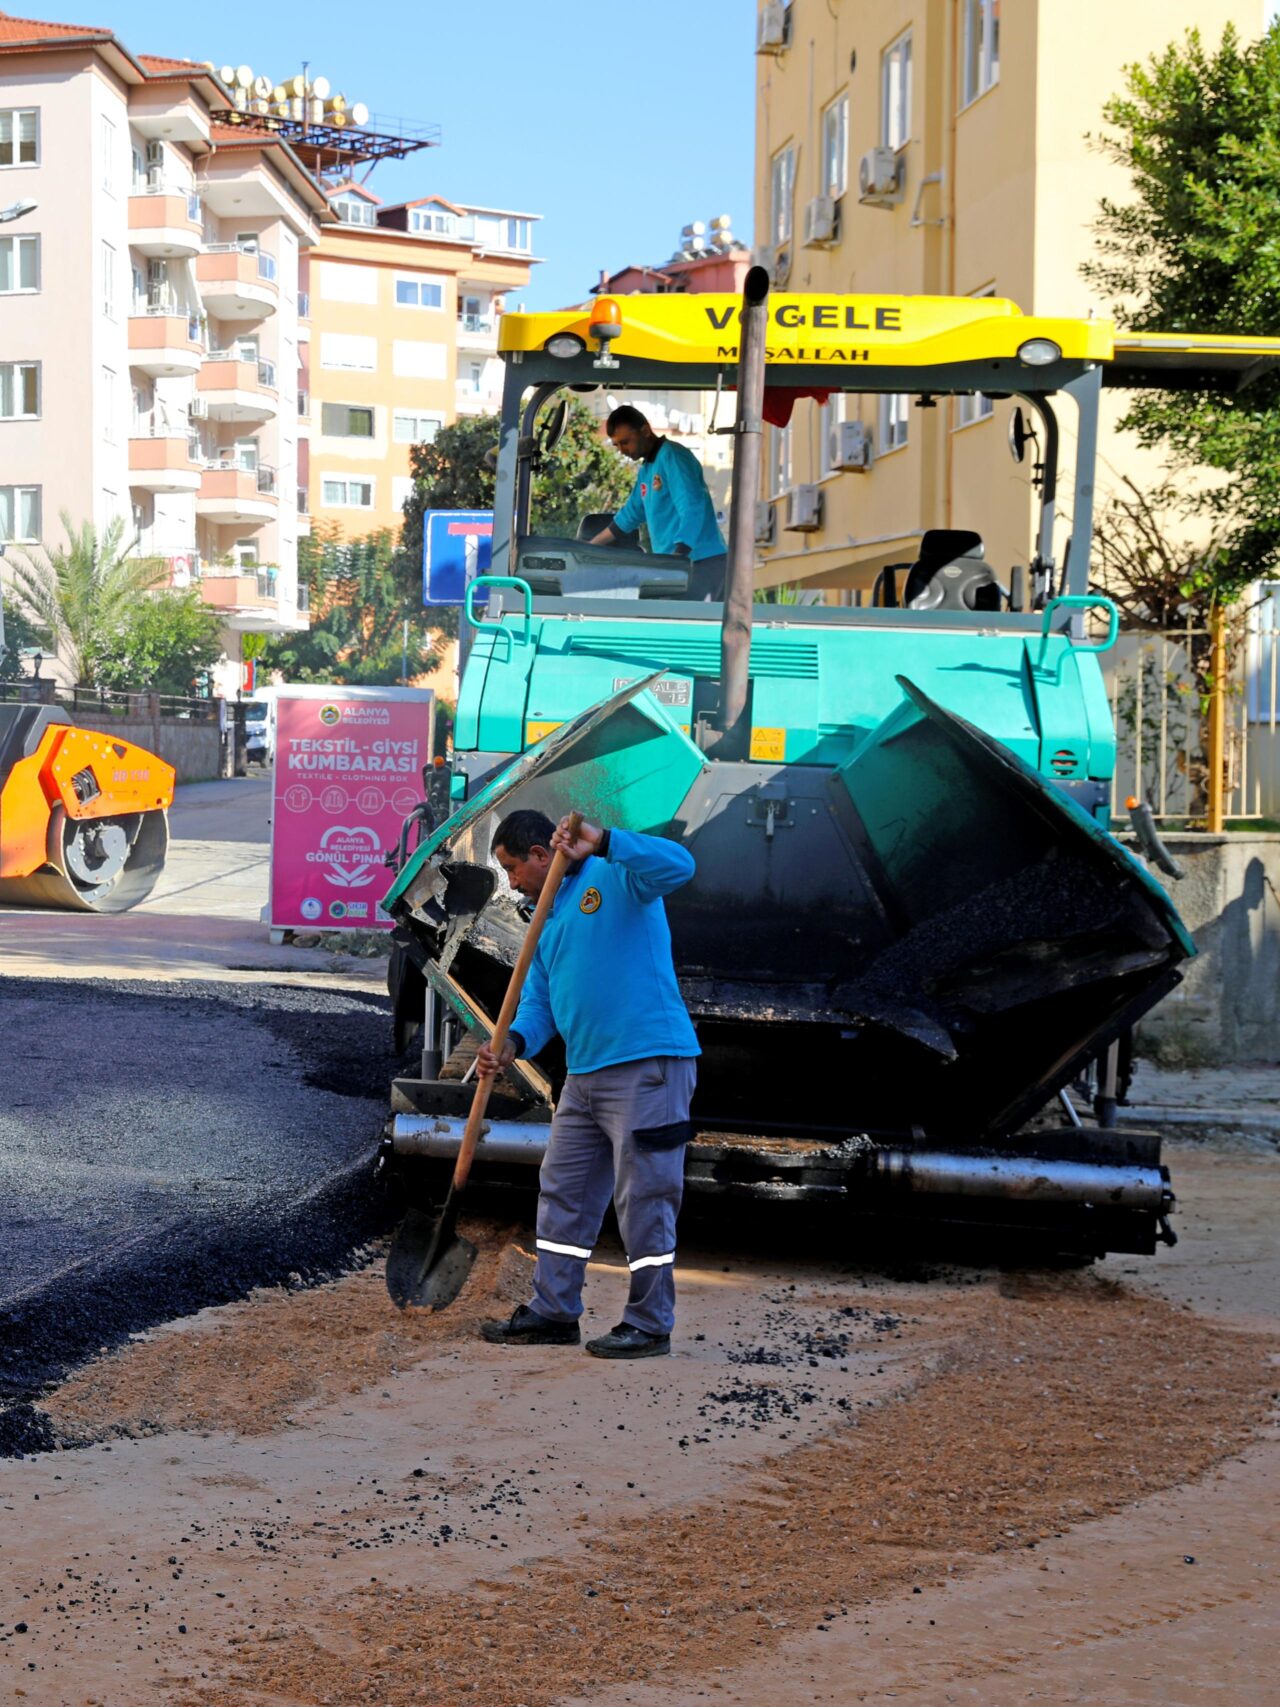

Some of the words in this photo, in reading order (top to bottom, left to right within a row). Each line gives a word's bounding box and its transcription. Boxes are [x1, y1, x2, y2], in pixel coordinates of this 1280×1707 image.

[717, 346, 870, 362] MŞALLAH
[343, 707, 390, 717] ALANYA
[342, 717, 390, 725] BELEDİYESİ
[289, 738, 361, 753] TEKSTİL
[372, 739, 418, 755] GİYSİ
[288, 754, 418, 772] KUMBARASI
[305, 850, 349, 863] GÖNÜL
